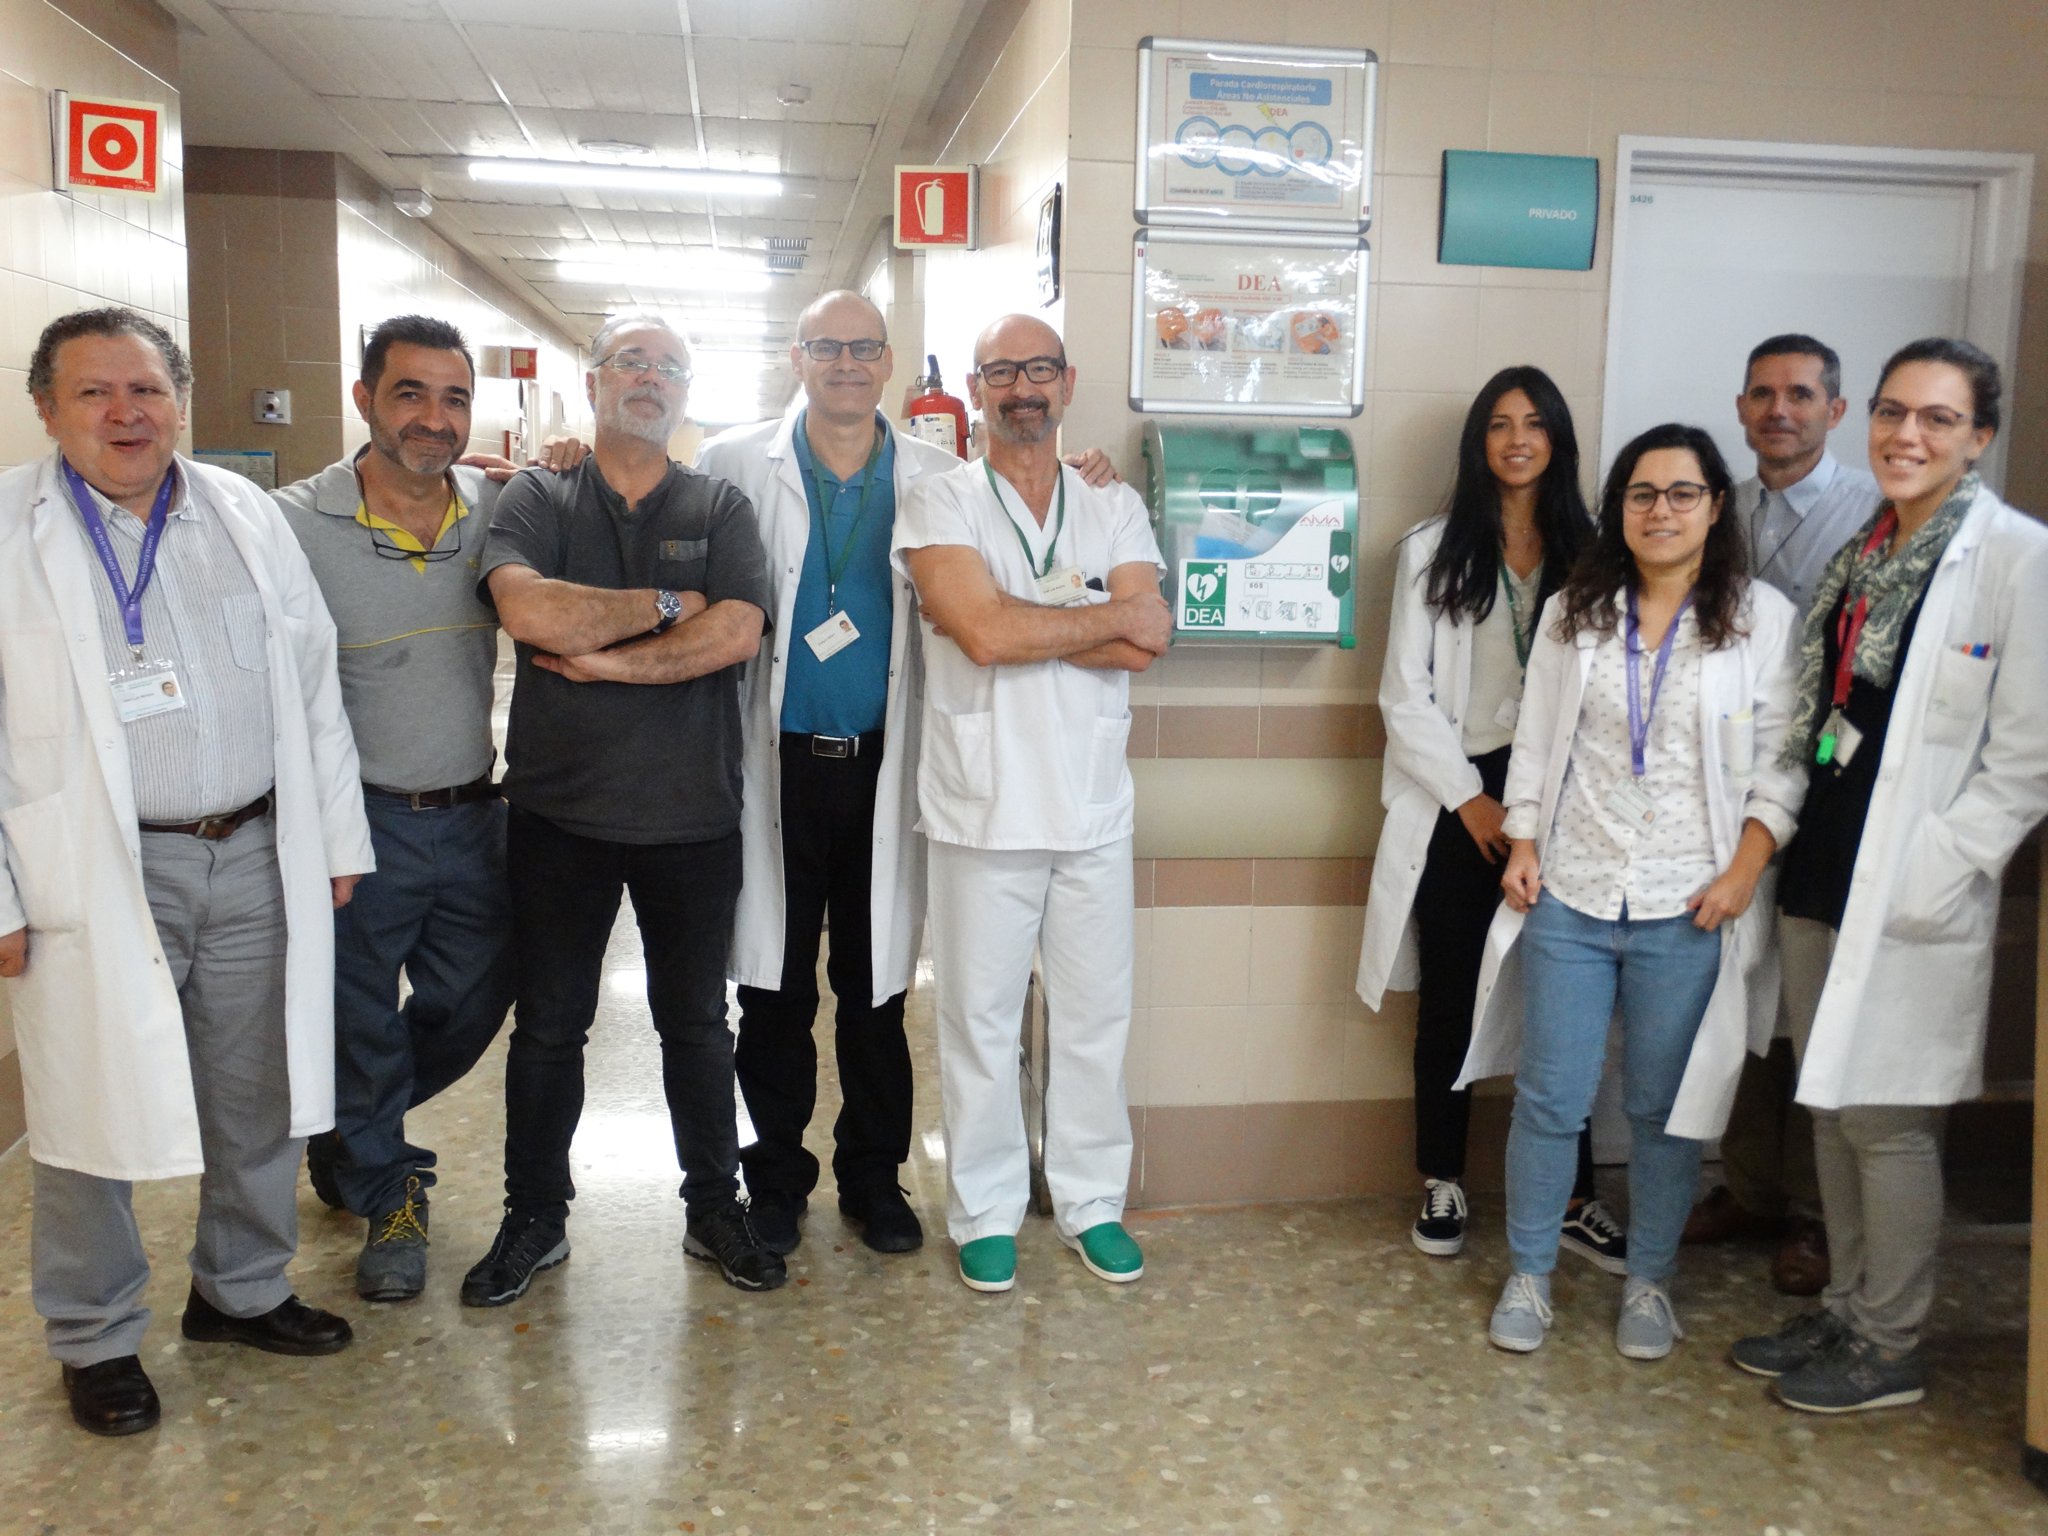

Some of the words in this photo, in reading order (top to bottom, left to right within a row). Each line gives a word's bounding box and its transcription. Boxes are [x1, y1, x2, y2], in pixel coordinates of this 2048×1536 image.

[1210, 78, 1239, 88] Parada
[1270, 108, 1288, 117] DEA
[1528, 207, 1577, 221] PRIVADO
[1237, 273, 1282, 292] DEA
[1185, 608, 1224, 625] DEA
